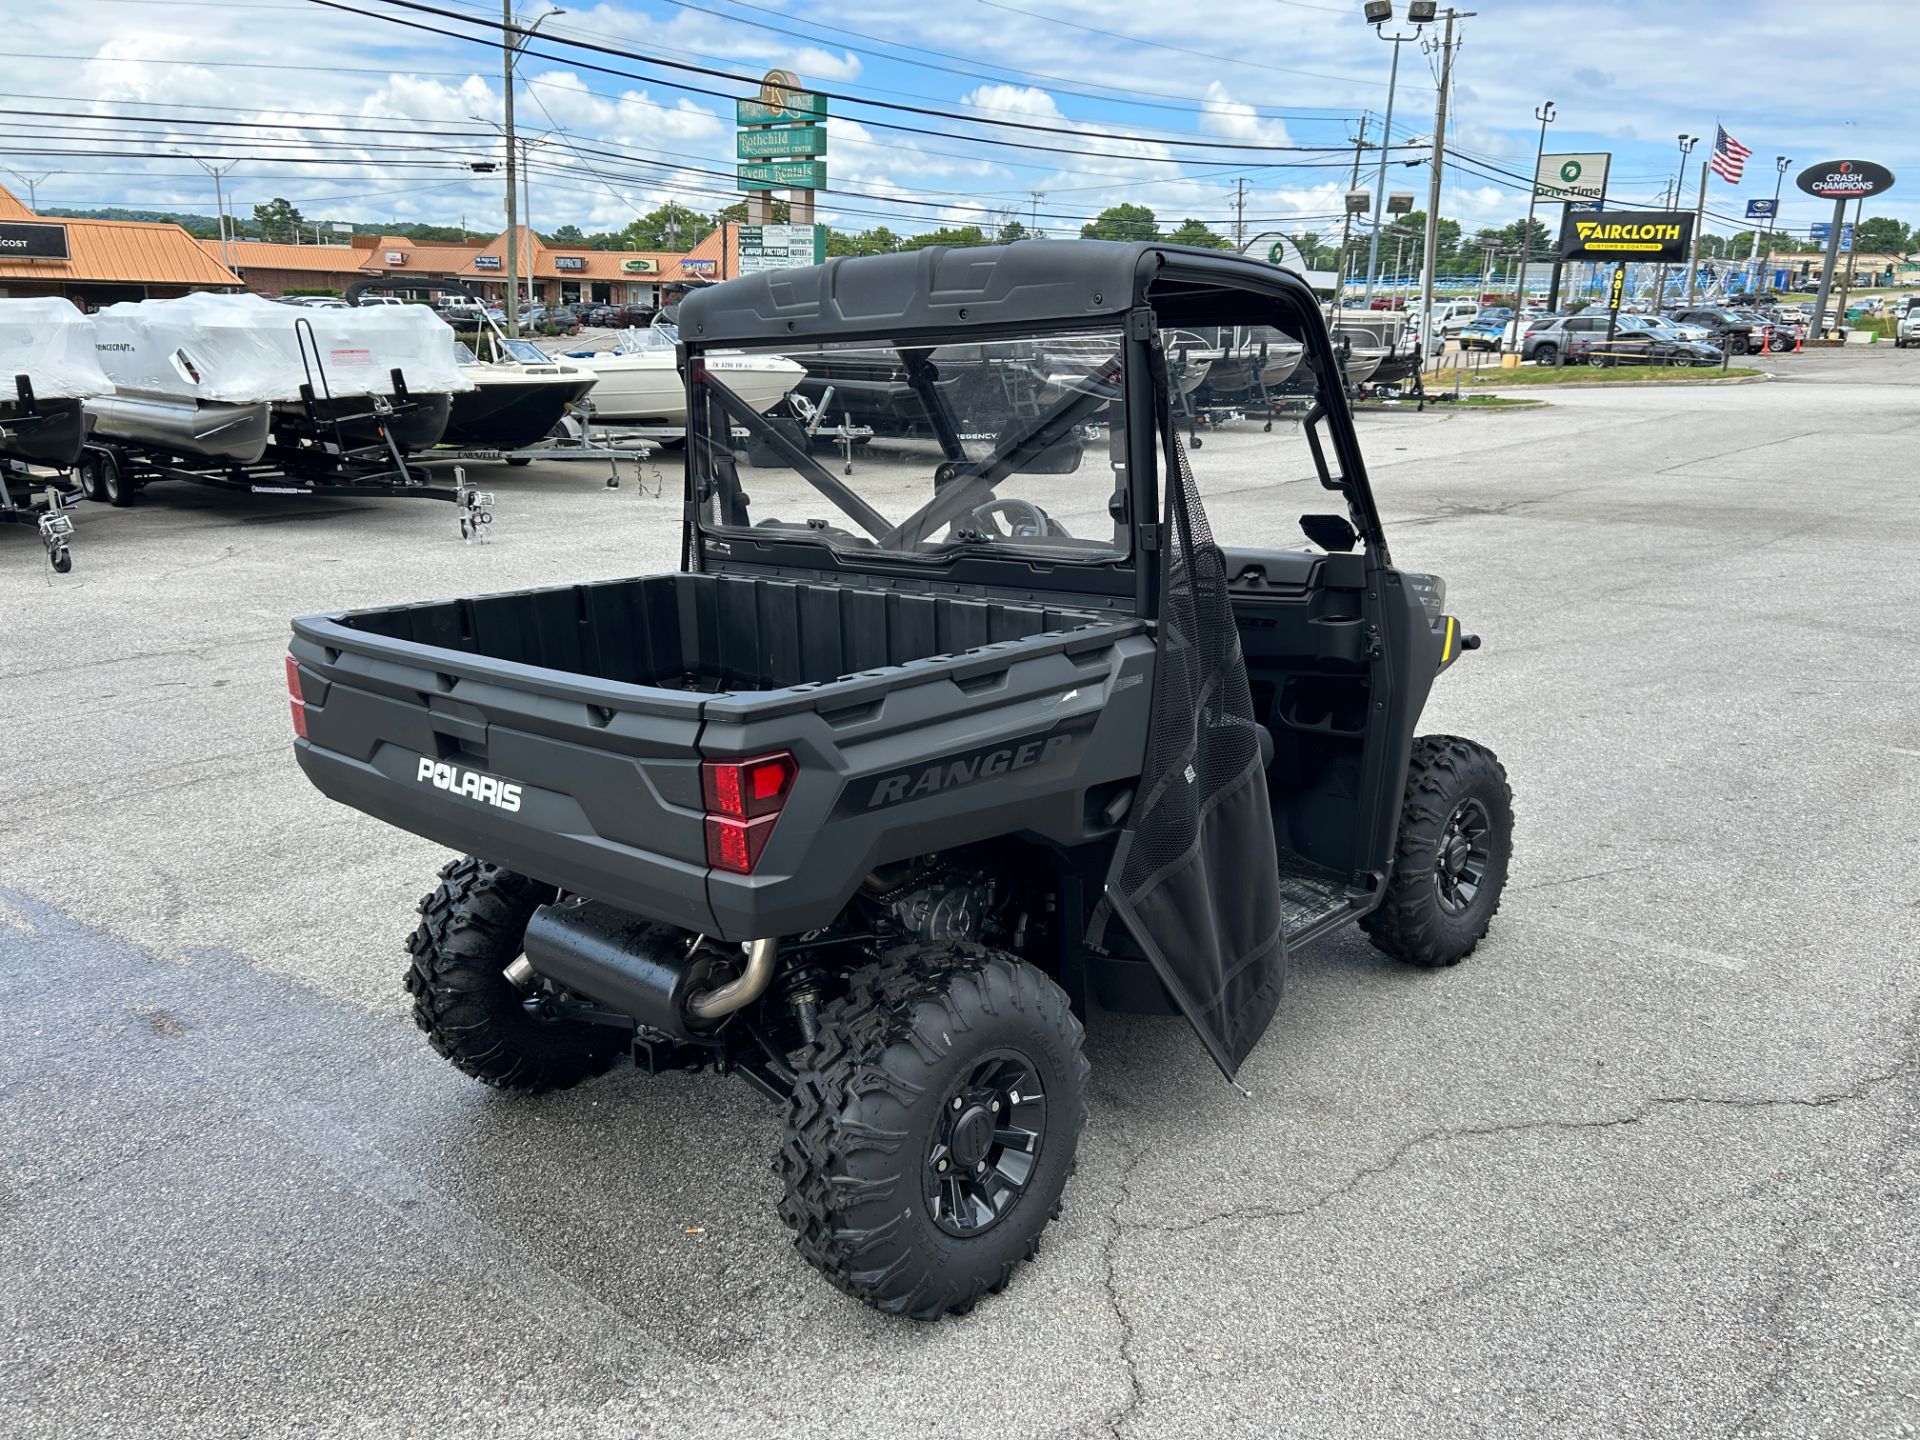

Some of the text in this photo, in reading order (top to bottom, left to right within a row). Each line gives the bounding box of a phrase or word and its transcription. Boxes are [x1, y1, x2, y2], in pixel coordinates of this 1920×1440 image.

[740, 132, 788, 148] Rothchild
[739, 163, 812, 180] Event Rentals
[1826, 173, 1863, 182] CRASH
[1535, 185, 1602, 197] DriveTime
[1812, 181, 1873, 190] CHAMPIONS
[1576, 222, 1680, 240] FAIRCLOTH
[0, 239, 28, 248] COST
[763, 247, 788, 257] FACTORY
[1610, 270, 1623, 309] 8812
[867, 734, 1073, 808] RANGER
[417, 757, 522, 812] POLARIS
